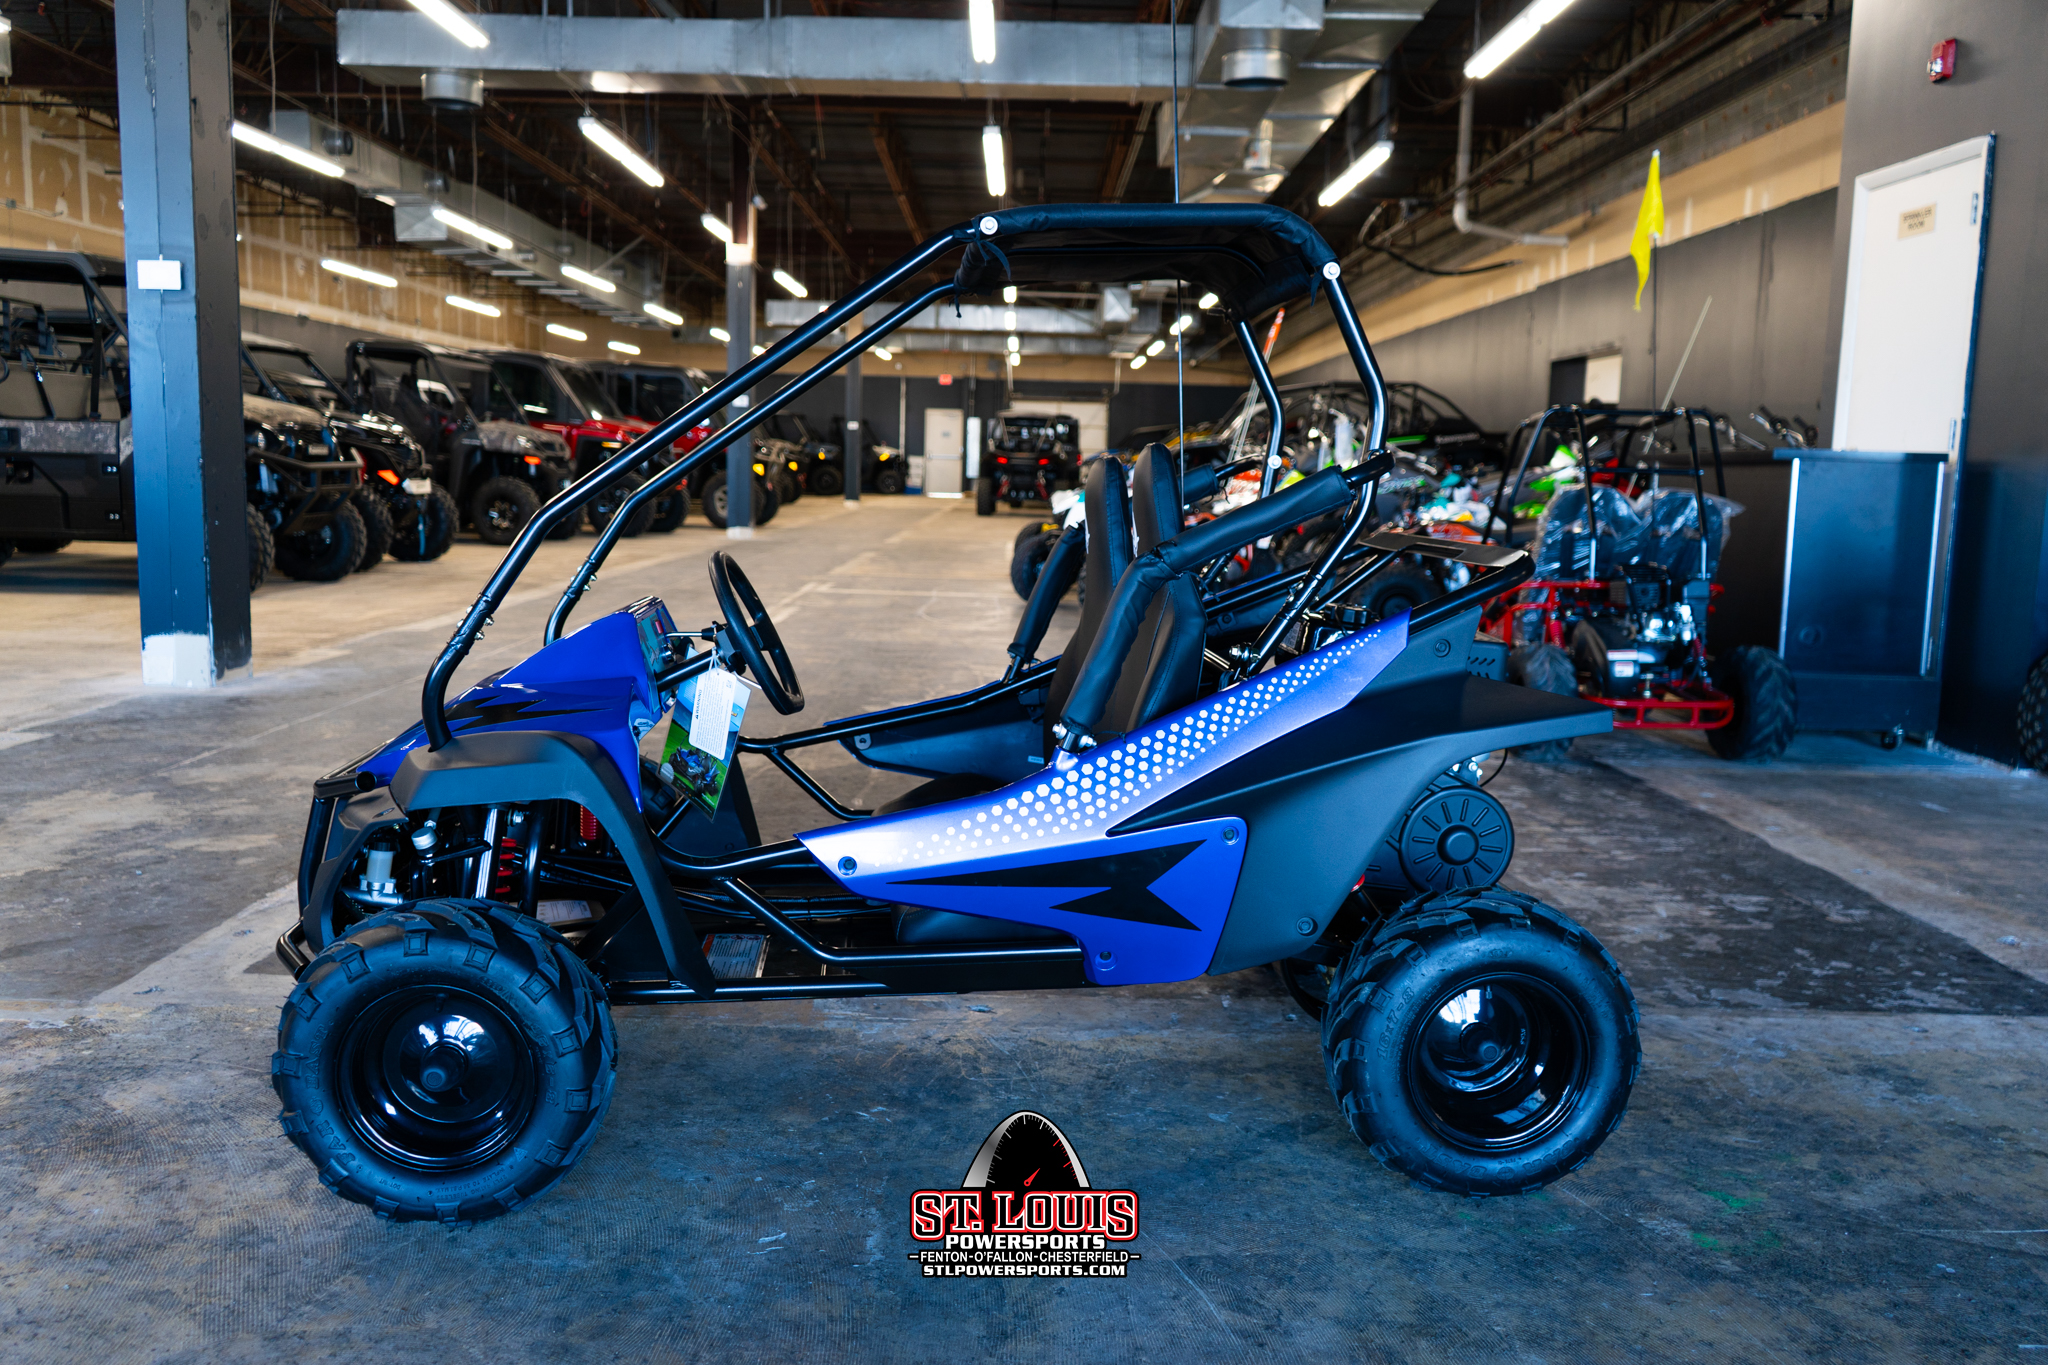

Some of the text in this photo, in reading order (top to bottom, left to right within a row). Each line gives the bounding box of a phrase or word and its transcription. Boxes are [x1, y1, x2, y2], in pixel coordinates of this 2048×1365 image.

[305, 1022, 331, 1090] EAST
[1377, 986, 1415, 1060] 16x7-8
[1419, 1141, 1487, 1180] EAST
